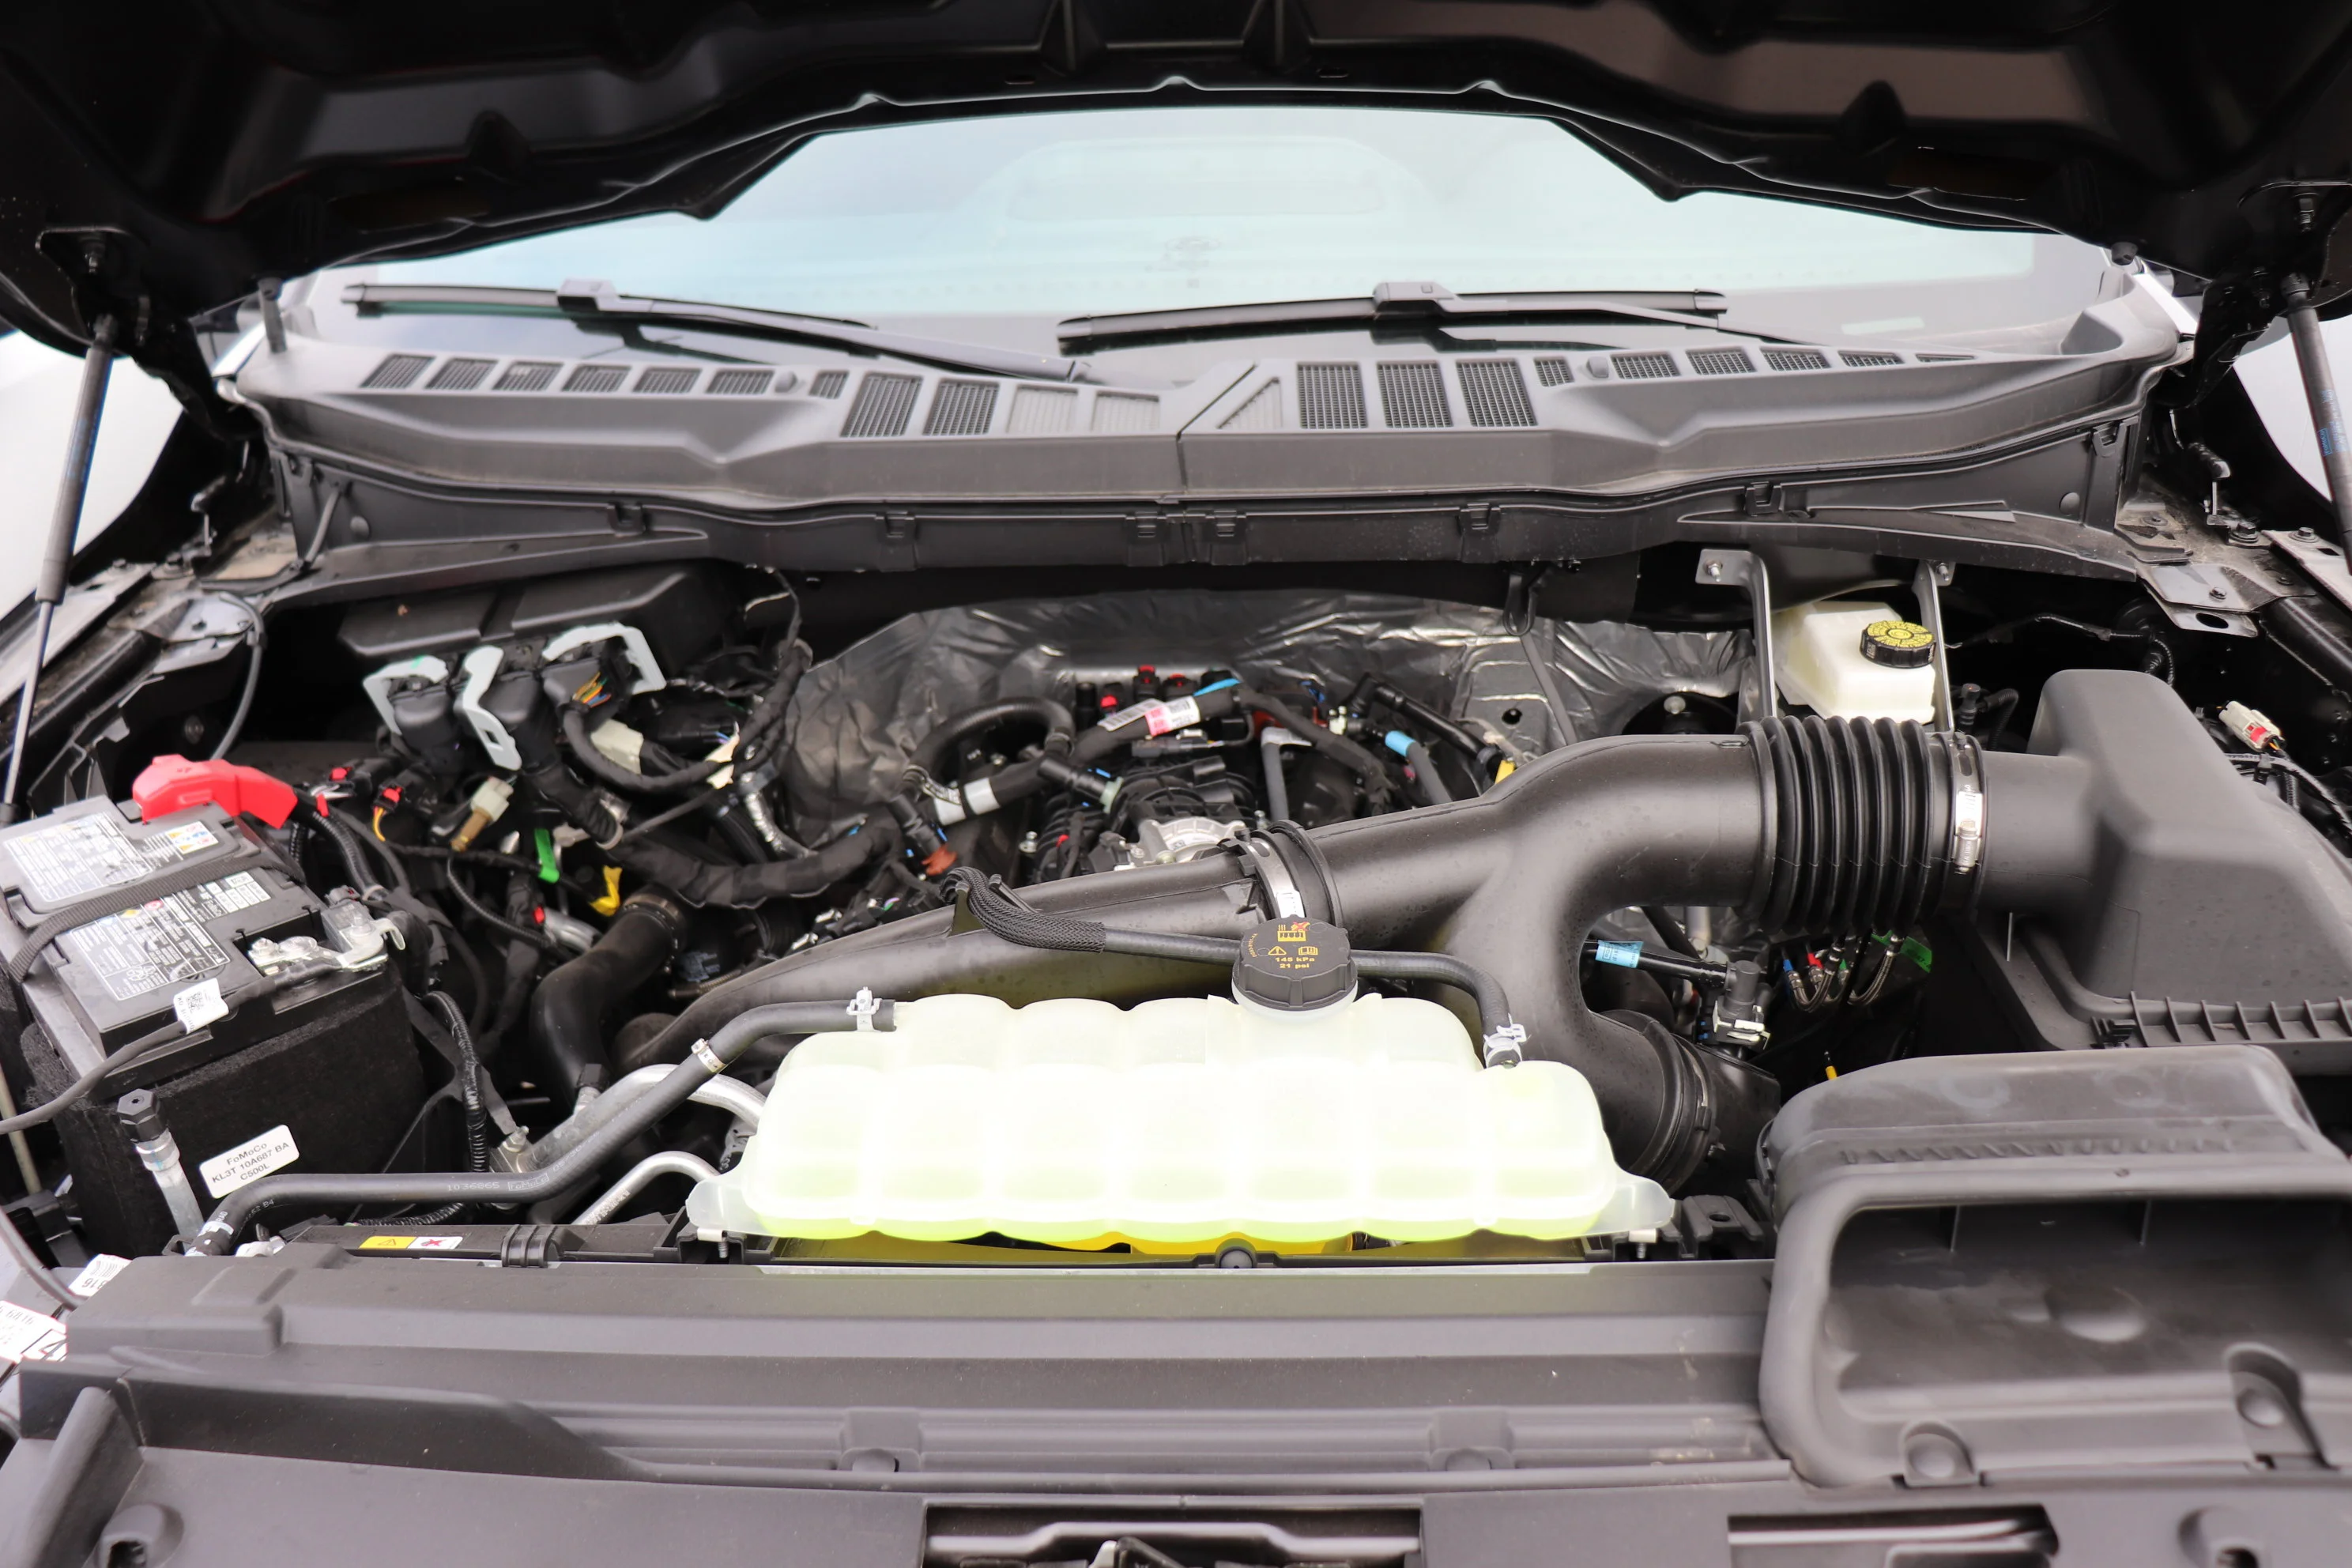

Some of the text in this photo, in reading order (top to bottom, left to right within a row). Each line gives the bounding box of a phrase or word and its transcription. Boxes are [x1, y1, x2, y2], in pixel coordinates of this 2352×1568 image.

[212, 1142, 289, 1183] KL3T 10A687 BA
[227, 1143, 267, 1165] FoMoCo
[240, 1163, 270, 1181] C500L
